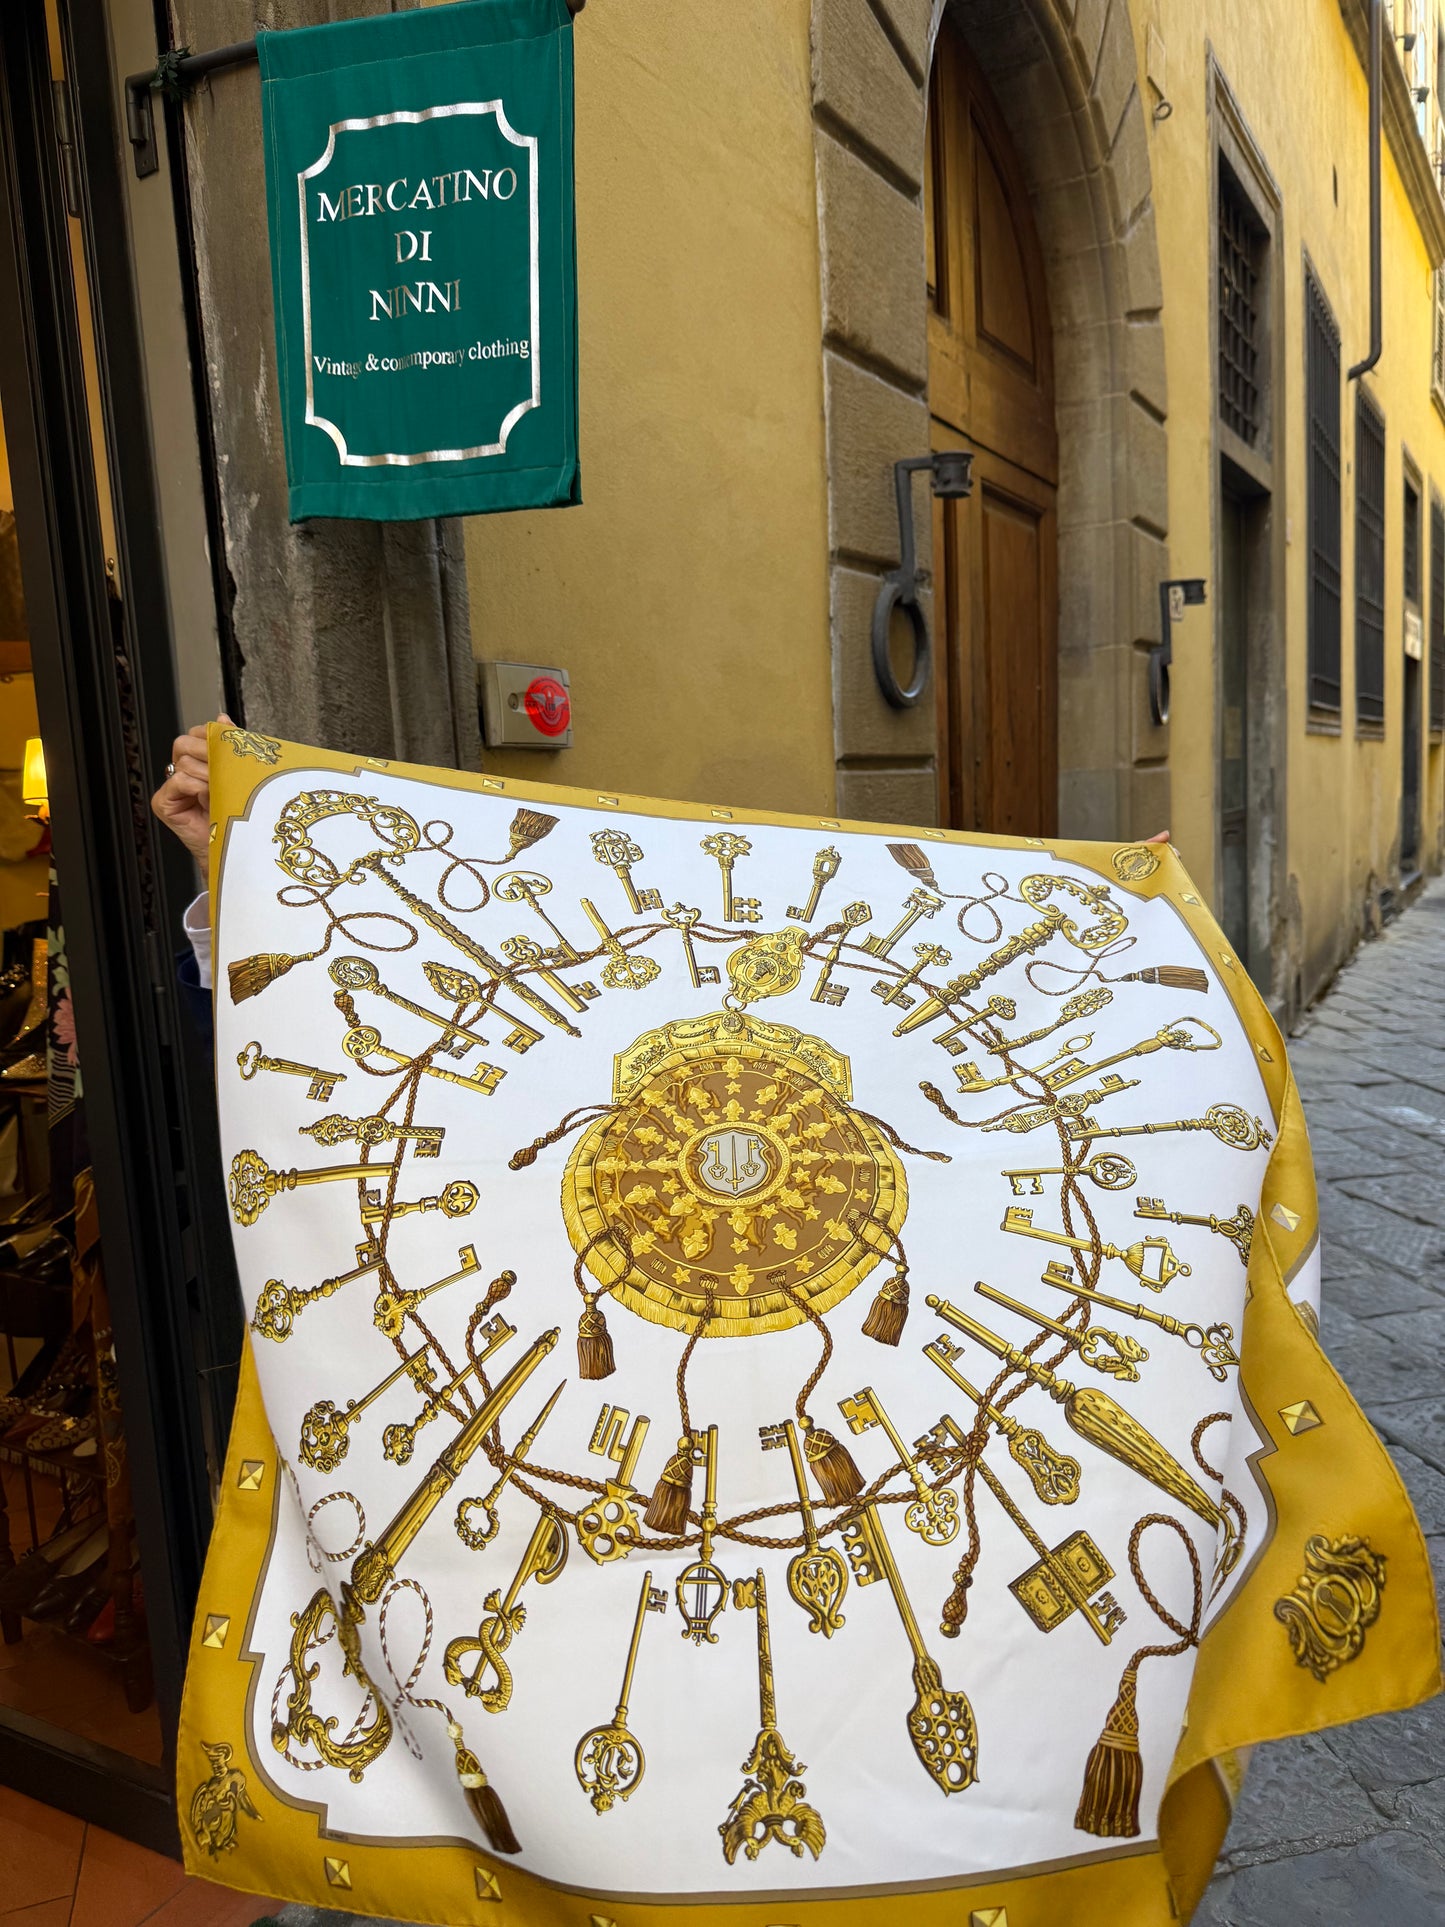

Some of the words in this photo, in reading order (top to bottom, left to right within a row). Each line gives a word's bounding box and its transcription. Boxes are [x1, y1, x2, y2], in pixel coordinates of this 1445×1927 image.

[317, 167, 517, 222] MERCATINO
[394, 231, 432, 264] DI
[369, 280, 461, 321] NINNI
[365, 353, 380, 372] &
[468, 339, 530, 360] clothing
